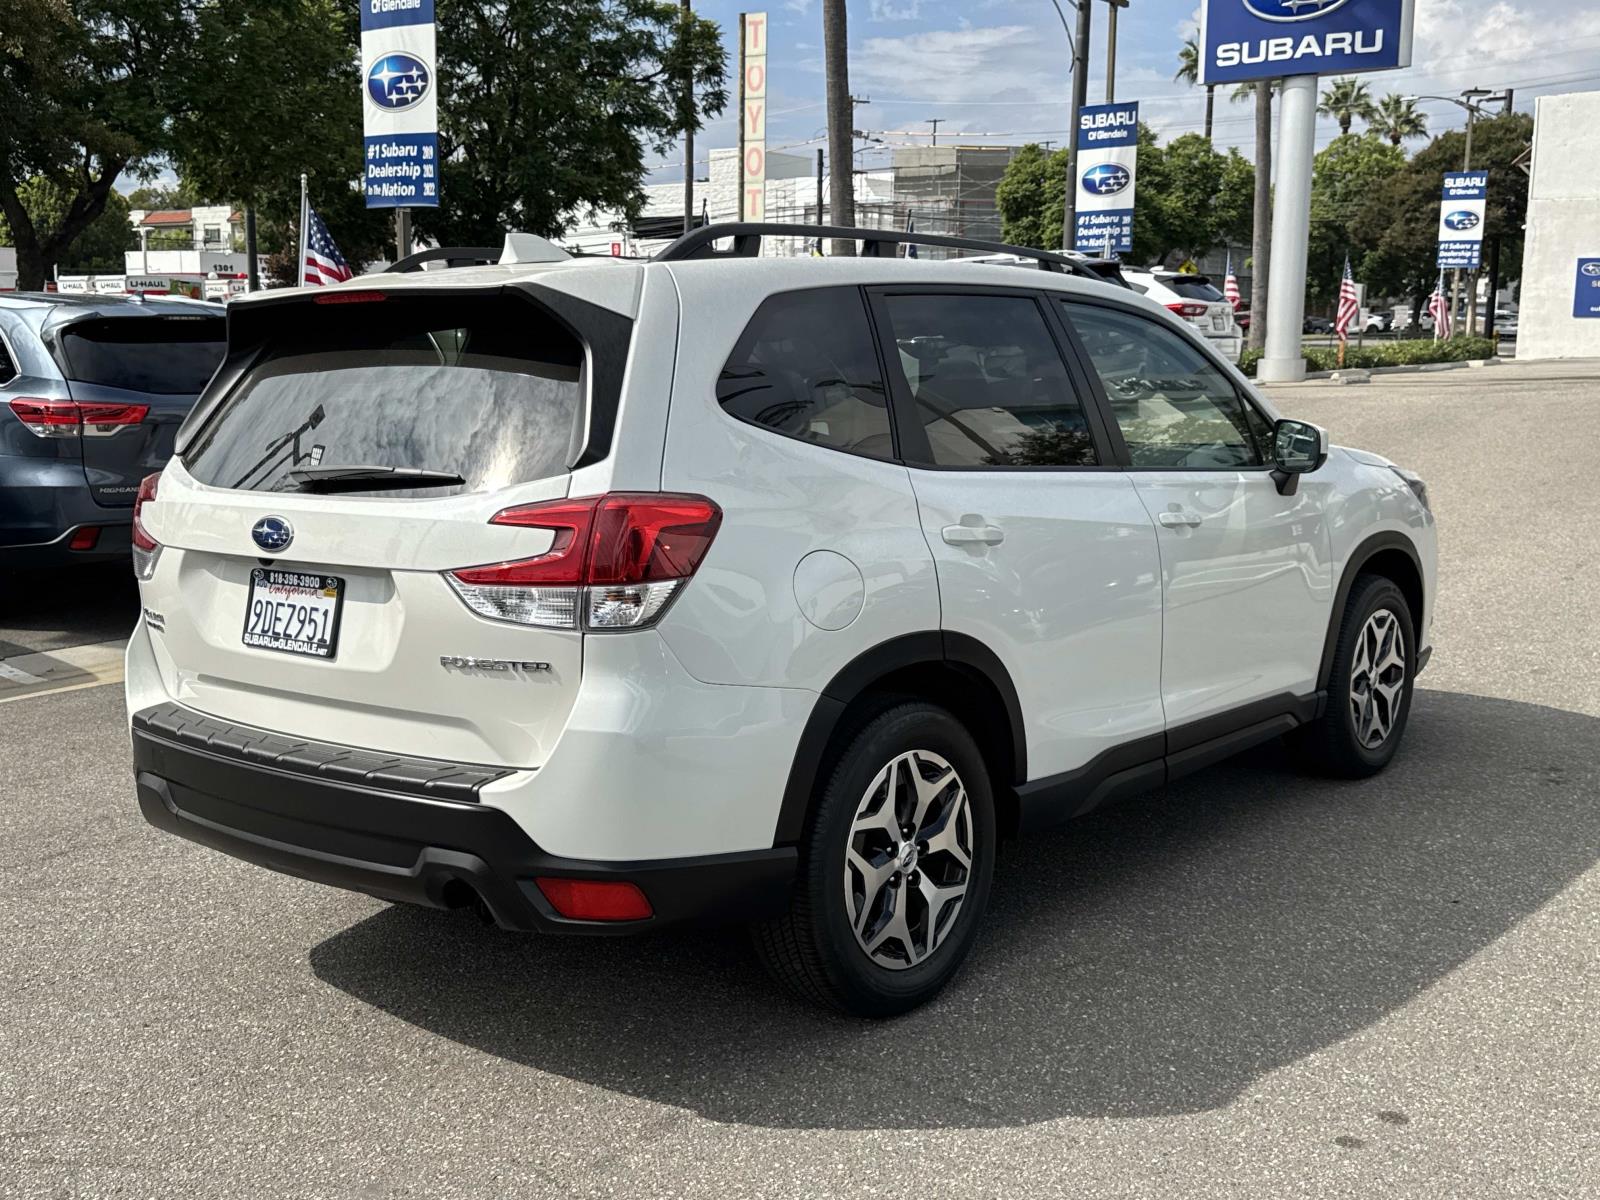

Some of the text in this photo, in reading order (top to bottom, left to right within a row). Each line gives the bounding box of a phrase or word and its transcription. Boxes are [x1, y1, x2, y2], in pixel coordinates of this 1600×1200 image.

[381, 0, 421, 12] Glendale
[1216, 29, 1384, 67] SUBARU
[1080, 110, 1136, 130] SUBARU
[367, 142, 418, 159] #1 Subaru
[368, 161, 421, 180] Dealership
[381, 182, 416, 197] Nation
[1444, 176, 1487, 188] SUBARU
[1090, 214, 1120, 224] Subaru
[1077, 225, 1121, 236] Dealership
[1089, 237, 1117, 247] Natin
[213, 264, 234, 272] 1301
[269, 572, 320, 588] 818-396-3900
[249, 599, 329, 643] 9DEZ951
